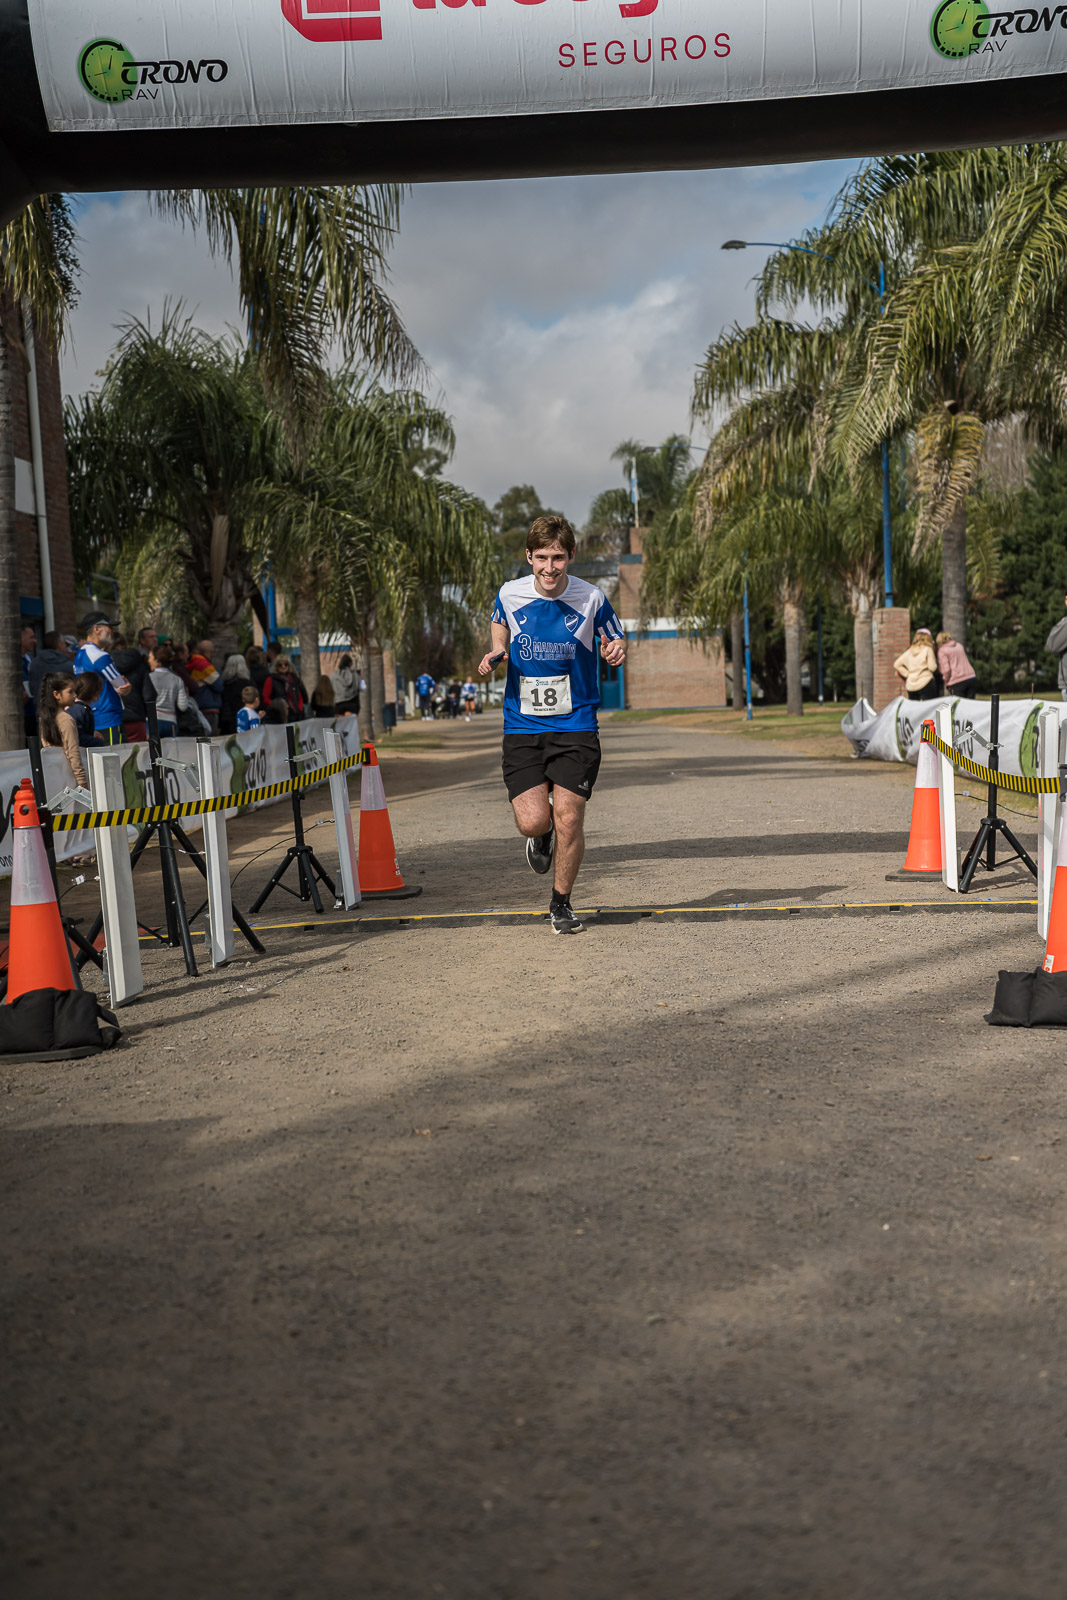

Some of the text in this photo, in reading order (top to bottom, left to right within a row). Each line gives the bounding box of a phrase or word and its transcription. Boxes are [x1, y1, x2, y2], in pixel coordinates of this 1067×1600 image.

[558, 32, 731, 68] SEGUROS
[968, 40, 1007, 55] RAV
[121, 59, 228, 85] CRONO
[122, 88, 159, 100] RAV
[518, 634, 532, 660] 3
[531, 688, 557, 706] 18
